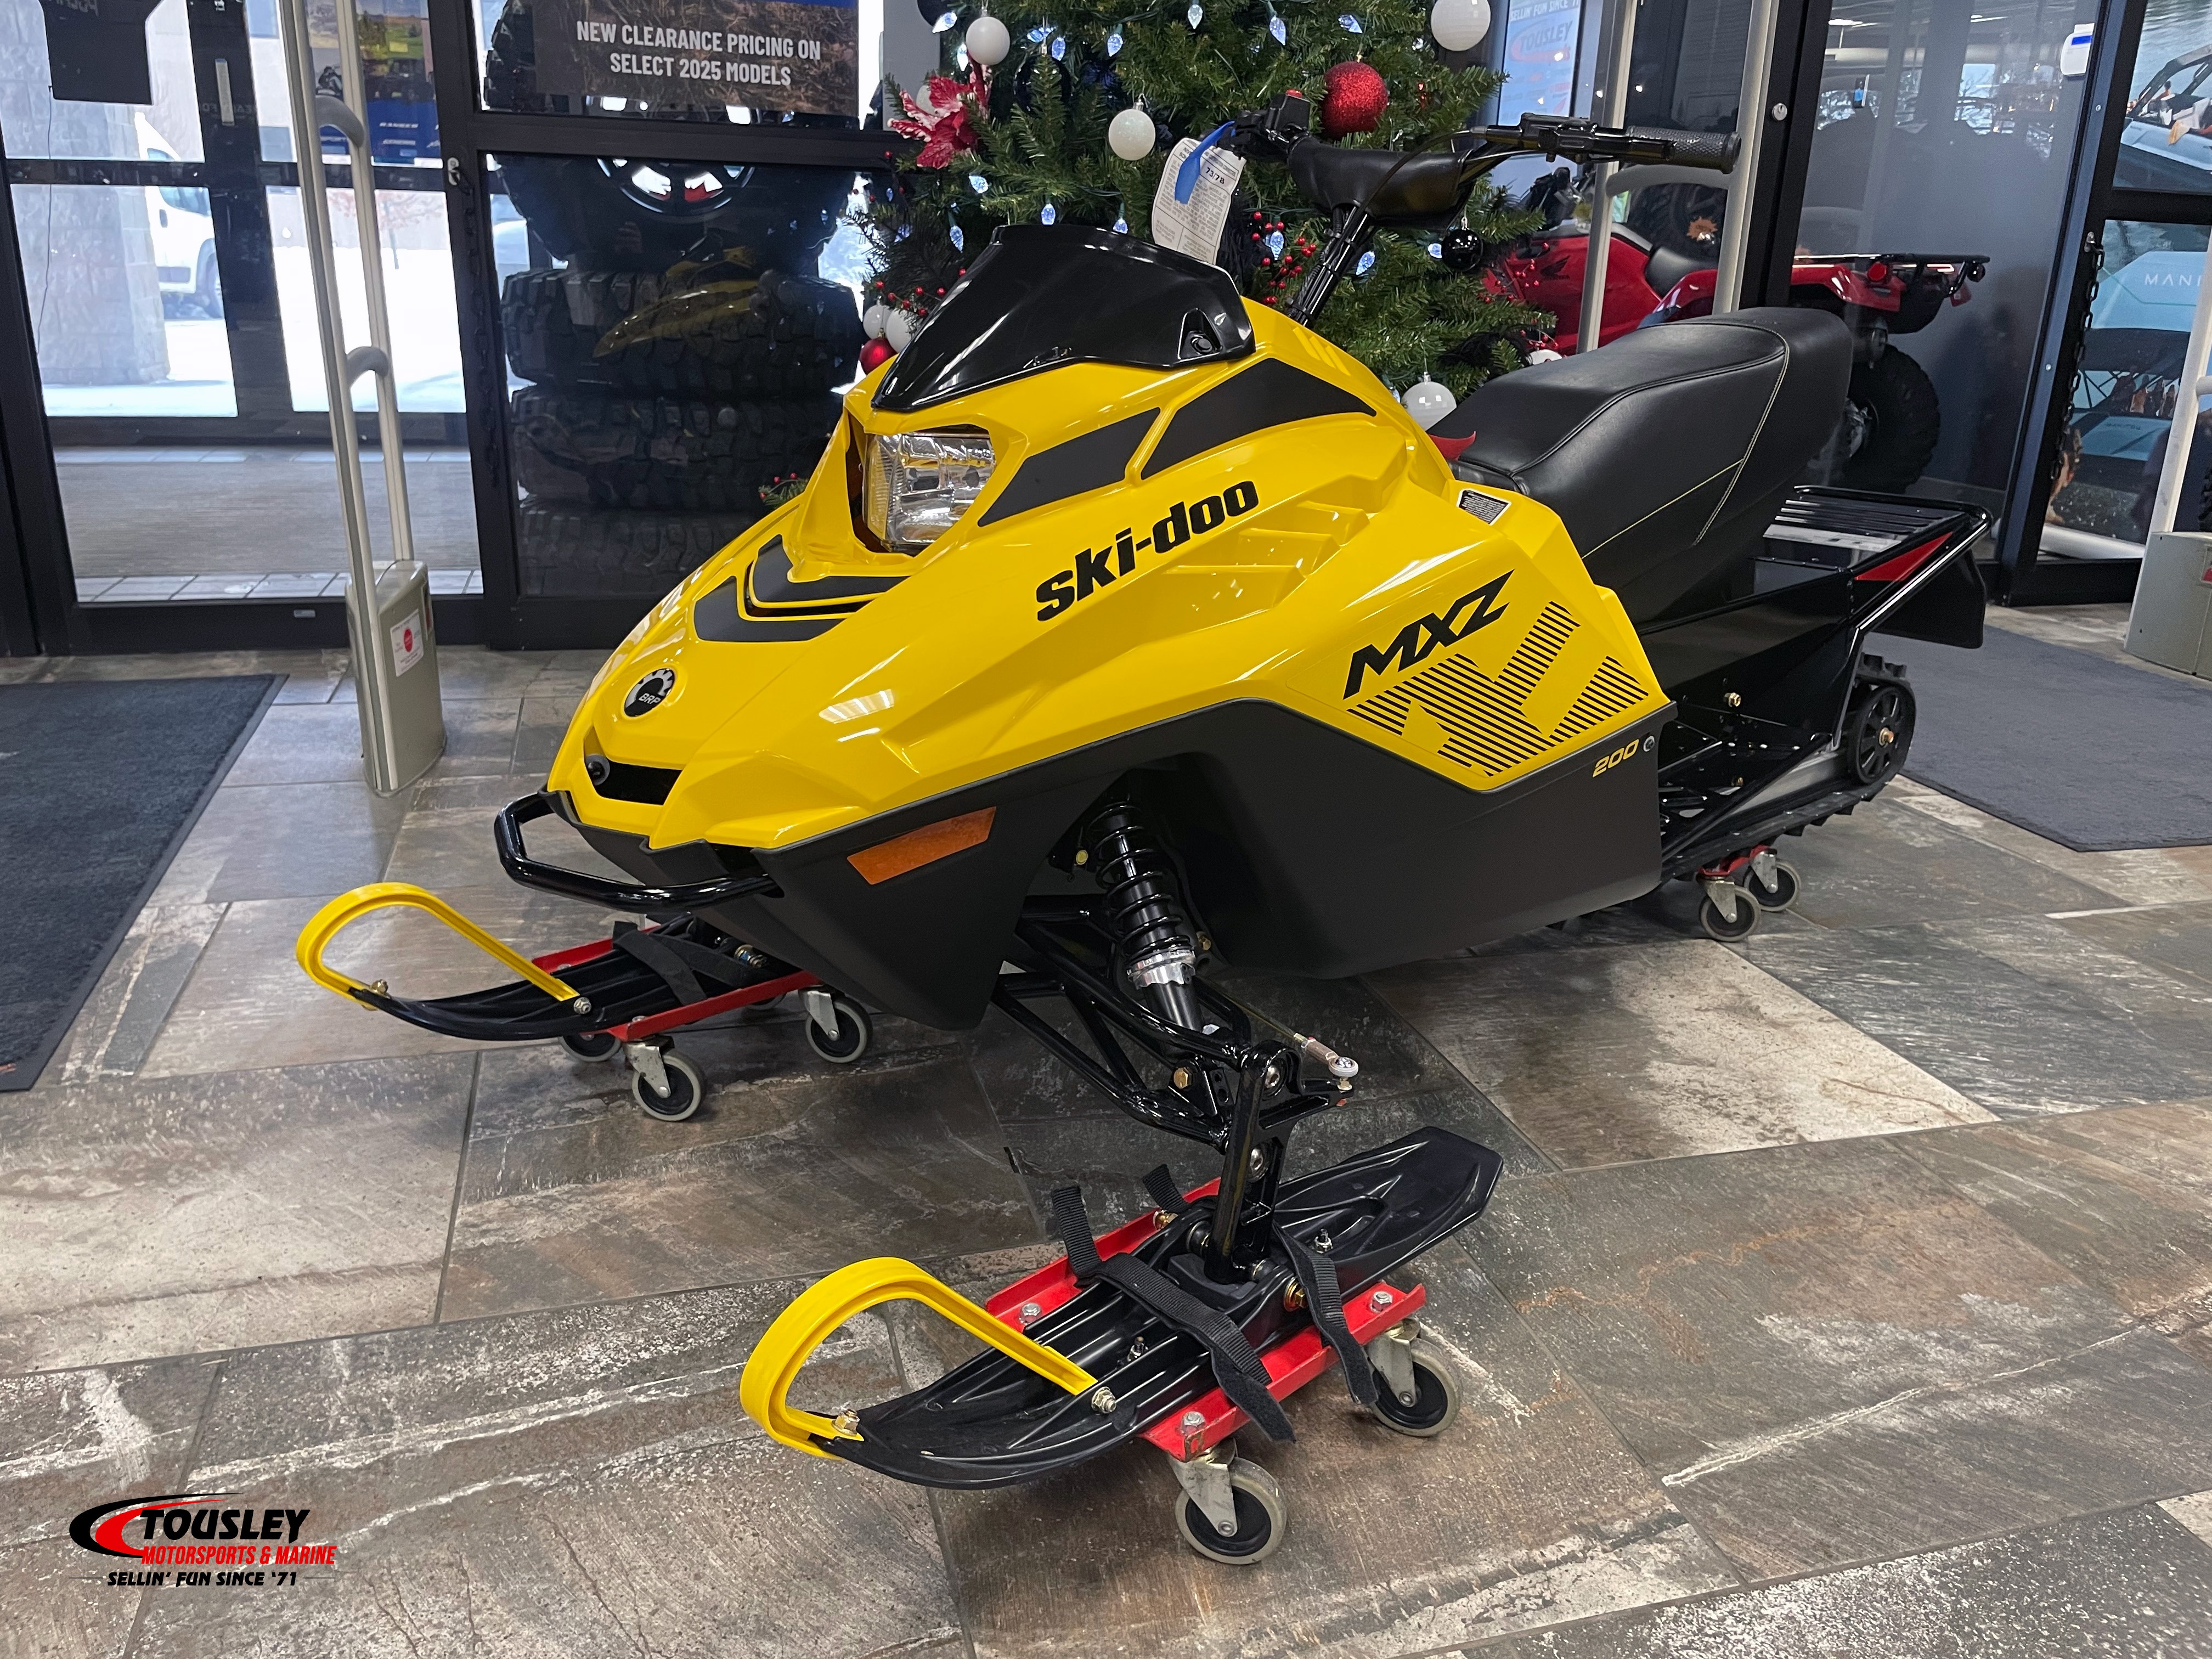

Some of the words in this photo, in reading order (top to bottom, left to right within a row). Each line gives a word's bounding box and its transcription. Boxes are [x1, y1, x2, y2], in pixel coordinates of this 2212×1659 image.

[577, 21, 617, 43] NEW
[622, 25, 723, 52] CLEARANCE
[727, 33, 794, 59] PRICING
[798, 39, 821, 60] ON
[610, 53, 674, 77] SELECT
[679, 58, 721, 81] 2025
[725, 61, 792, 86] MODELS
[1035, 480, 1260, 622] ski-doo
[1343, 568, 1515, 701] MXZ
[638, 693, 662, 704] BRP
[1592, 738, 1640, 778] 200
